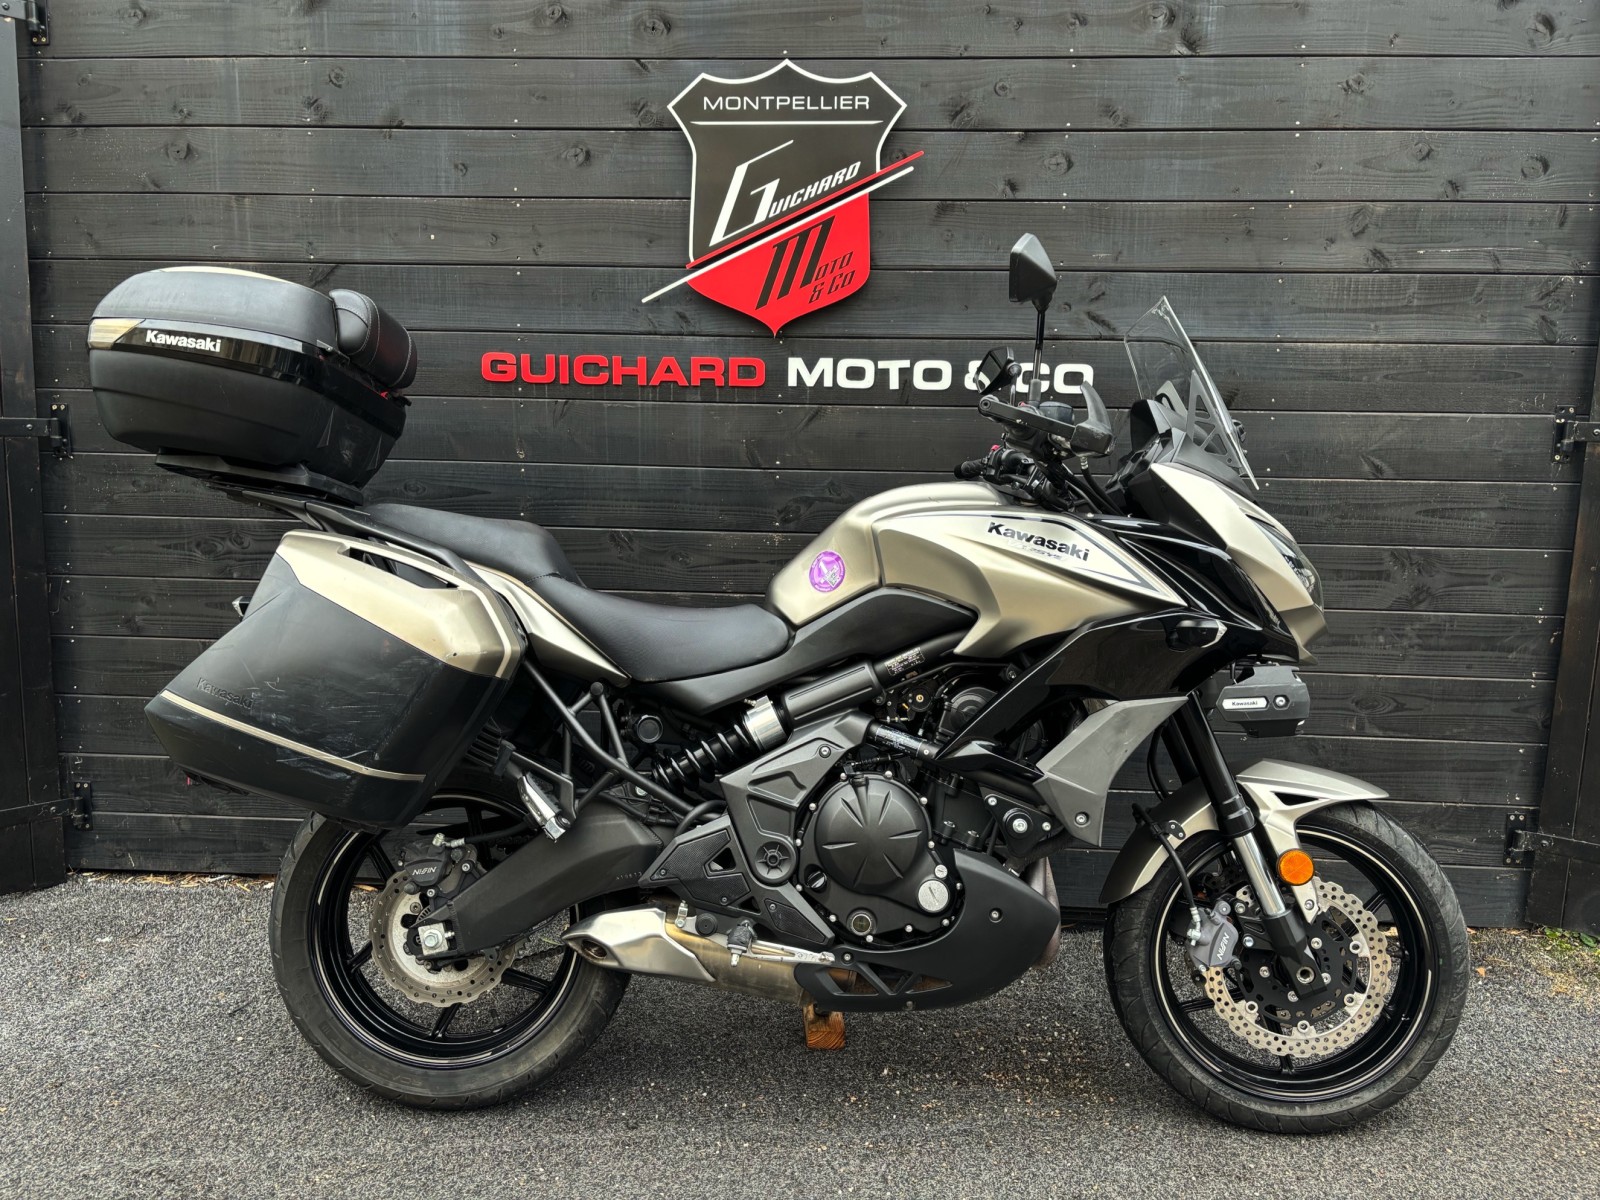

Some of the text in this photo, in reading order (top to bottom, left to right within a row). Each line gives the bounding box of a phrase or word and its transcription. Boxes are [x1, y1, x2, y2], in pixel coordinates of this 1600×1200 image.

[702, 95, 870, 111] MONTPELLIER
[808, 281, 826, 304] &
[145, 329, 222, 353] Kawasaki
[481, 351, 766, 387] GUICHARD
[787, 356, 953, 391] MOTO
[1015, 362, 1094, 394] CO
[987, 521, 1090, 562] Kawasaki
[196, 676, 255, 710] Kawasaki
